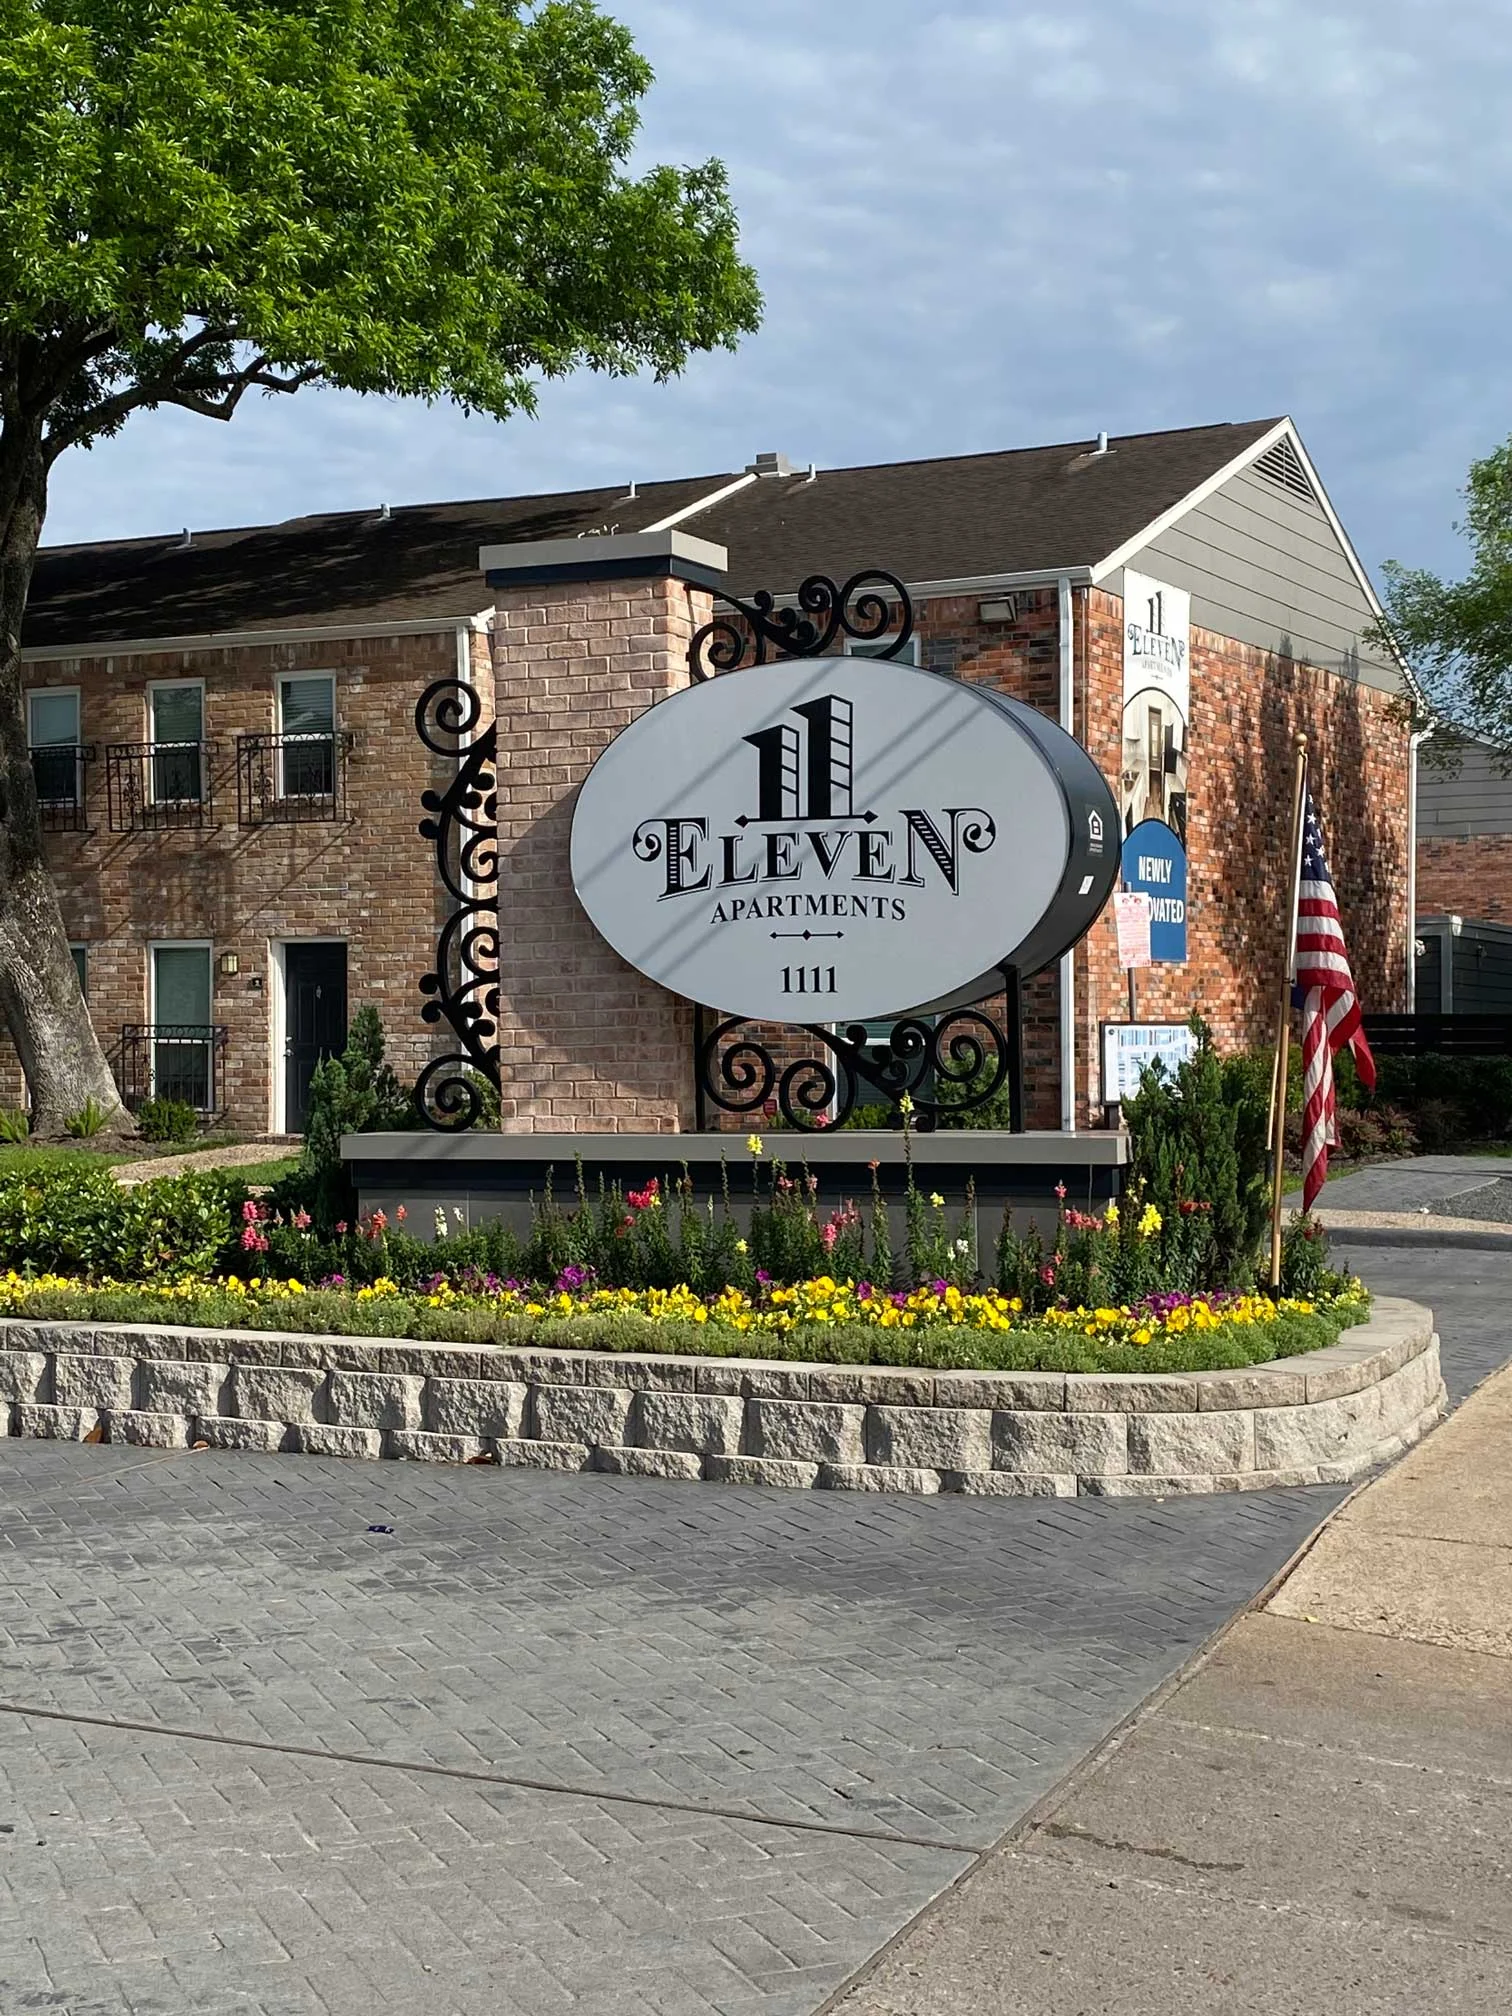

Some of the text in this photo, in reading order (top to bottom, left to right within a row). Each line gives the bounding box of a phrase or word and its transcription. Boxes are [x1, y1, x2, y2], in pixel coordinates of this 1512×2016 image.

[1127, 623, 1185, 672] ELEVEN
[632, 808, 997, 902] ELEVEN
[1138, 857, 1172, 883] NEWLY
[710, 894, 906, 924] APARTMENTS
[781, 966, 838, 994] 1111
